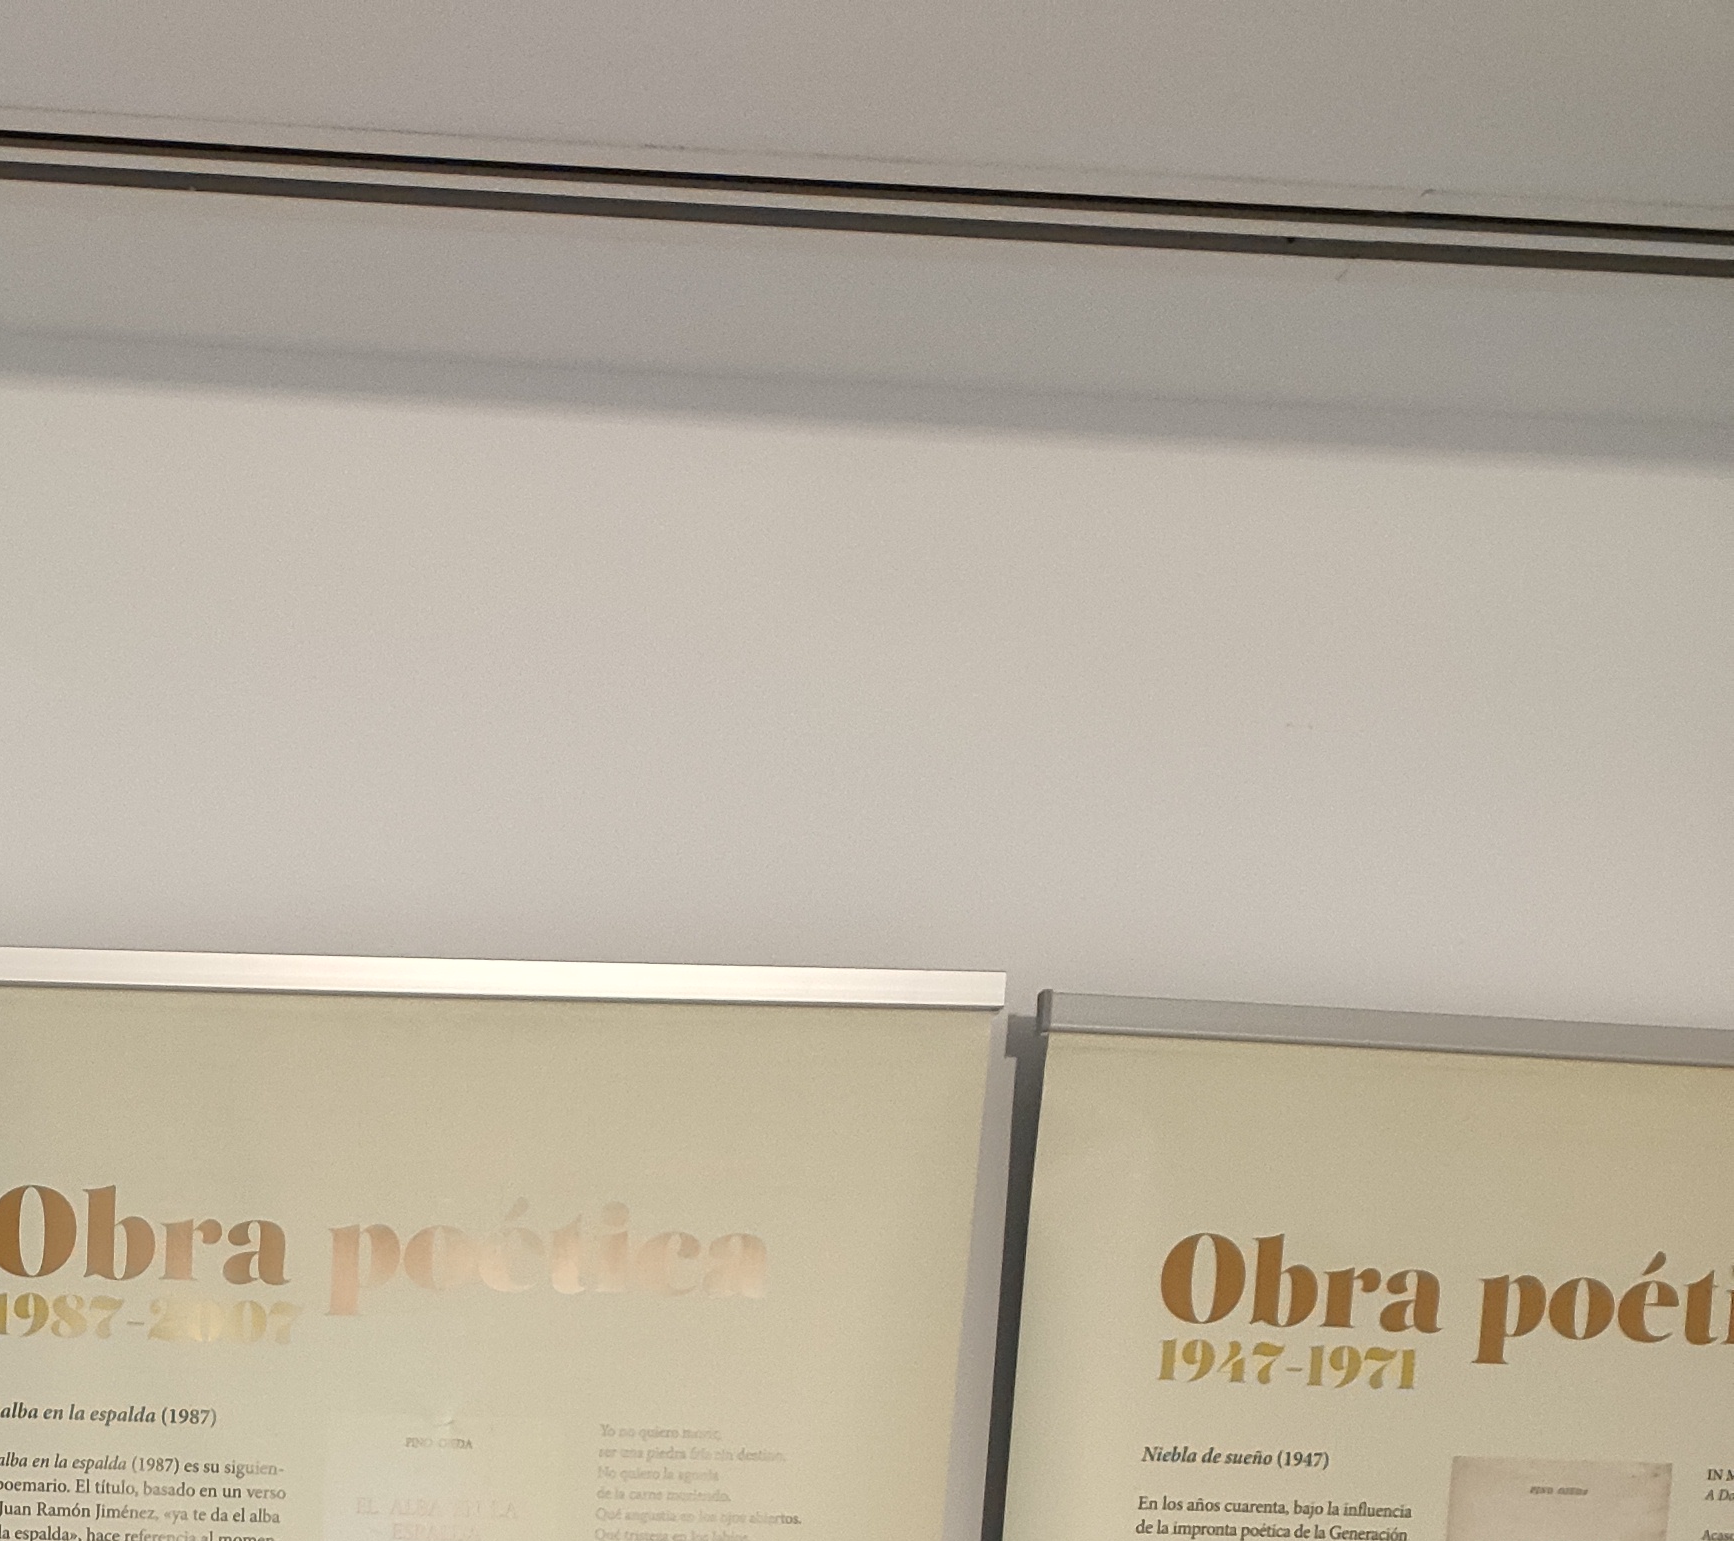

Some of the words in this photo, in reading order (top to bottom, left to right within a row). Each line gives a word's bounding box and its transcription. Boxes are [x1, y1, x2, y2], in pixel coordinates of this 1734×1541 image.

[327, 1197, 769, 1317] poética
[1160, 1232, 1443, 1334] Obra
[1159, 1338, 1416, 1390] 1947-1971
[0, 1401, 39, 1420] alba
[42, 1408, 64, 1421] en
[68, 1403, 86, 1421] la
[89, 1405, 156, 1428] espalda
[161, 1406, 217, 1429] (1987)
[1140, 1445, 1198, 1464] Niebla
[1200, 1446, 1223, 1465] de
[1223, 1449, 1273, 1466] sueño
[1276, 1449, 1330, 1471] (1947)
[1707, 1468, 1723, 1481] IN
[1137, 1495, 1159, 1511] En
[1161, 1494, 1184, 1512] los
[1185, 1497, 1221, 1513] años
[1223, 1501, 1290, 1516] cuarenta,
[1292, 1499, 1325, 1520] bajo
[1326, 1500, 1340, 1517] la
[1342, 1500, 1413, 1519] influencia
